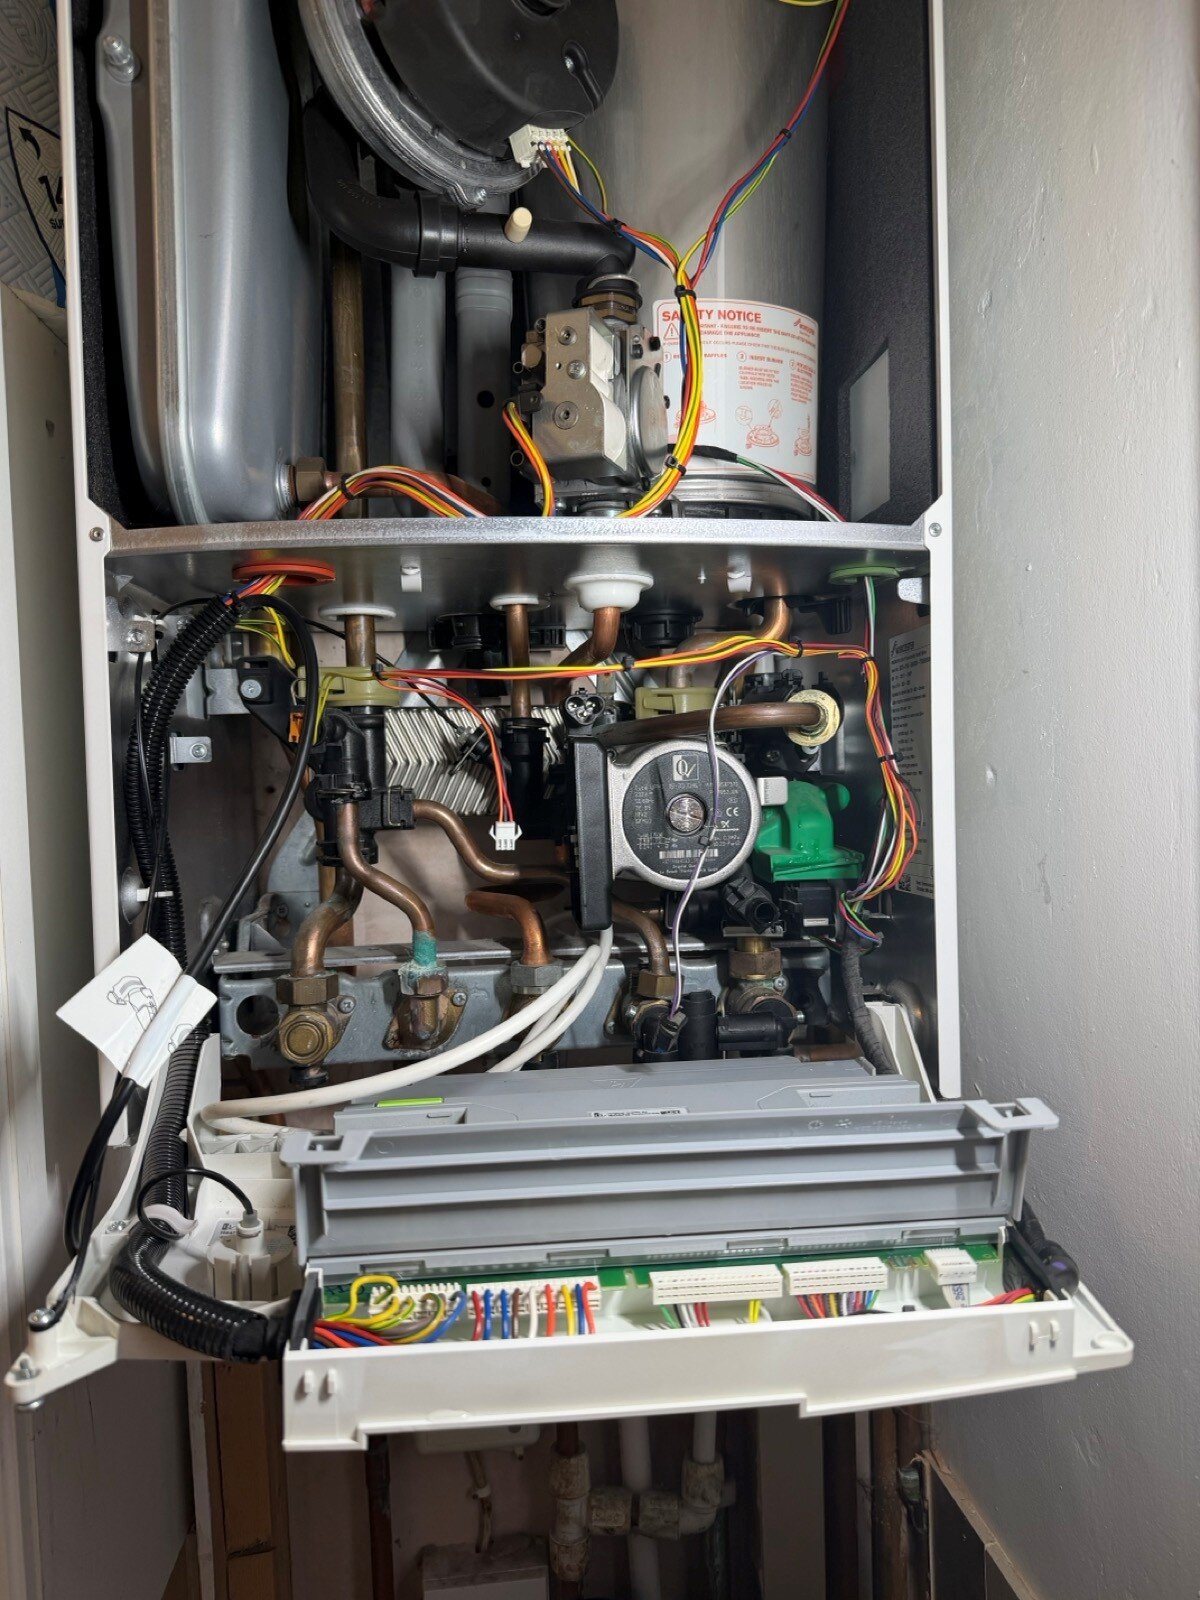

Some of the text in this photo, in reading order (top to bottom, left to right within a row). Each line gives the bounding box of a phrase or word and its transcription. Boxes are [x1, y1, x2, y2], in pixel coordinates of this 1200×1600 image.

[49, 217, 64, 230] SU
[662, 309, 762, 324] SATY NOTICE
[726, 807, 739, 817] CE
